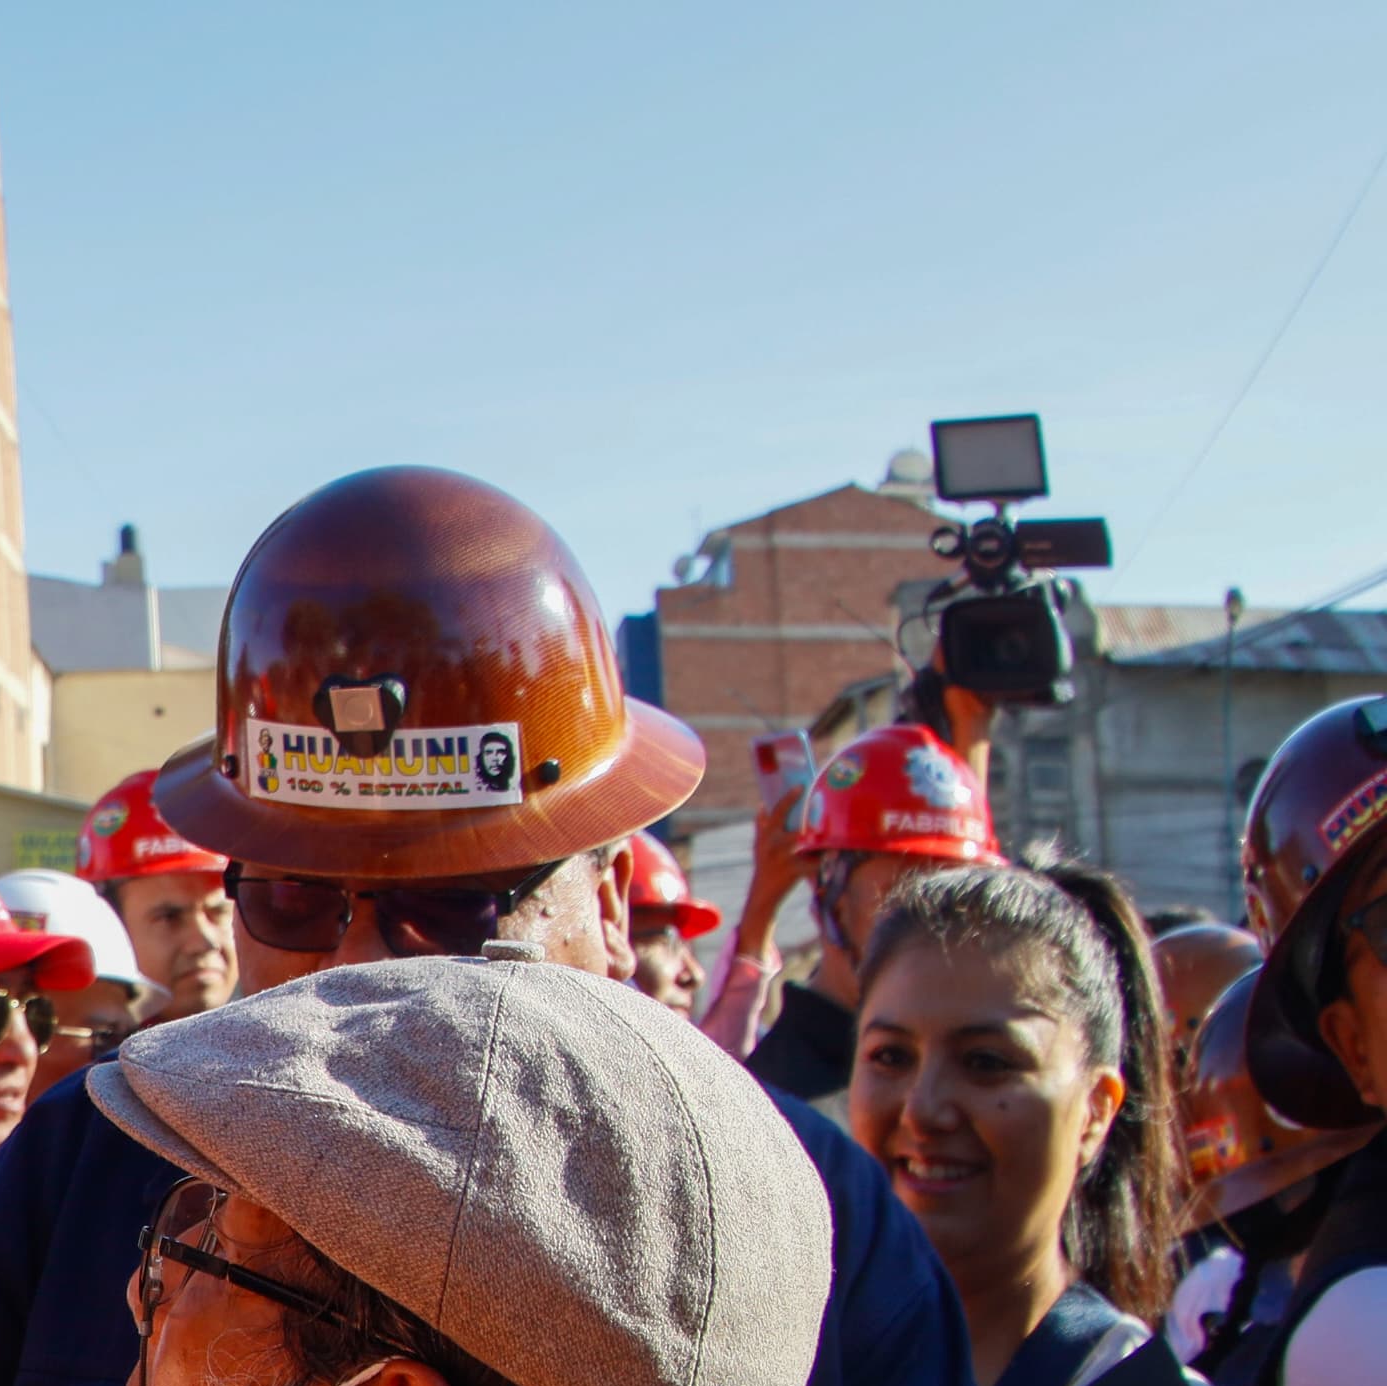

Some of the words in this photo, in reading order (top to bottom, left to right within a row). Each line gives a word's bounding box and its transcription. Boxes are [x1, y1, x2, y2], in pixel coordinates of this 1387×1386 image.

[287, 777, 324, 793] 100
[329, 781, 351, 796] %
[358, 781, 470, 796] ESTATAL
